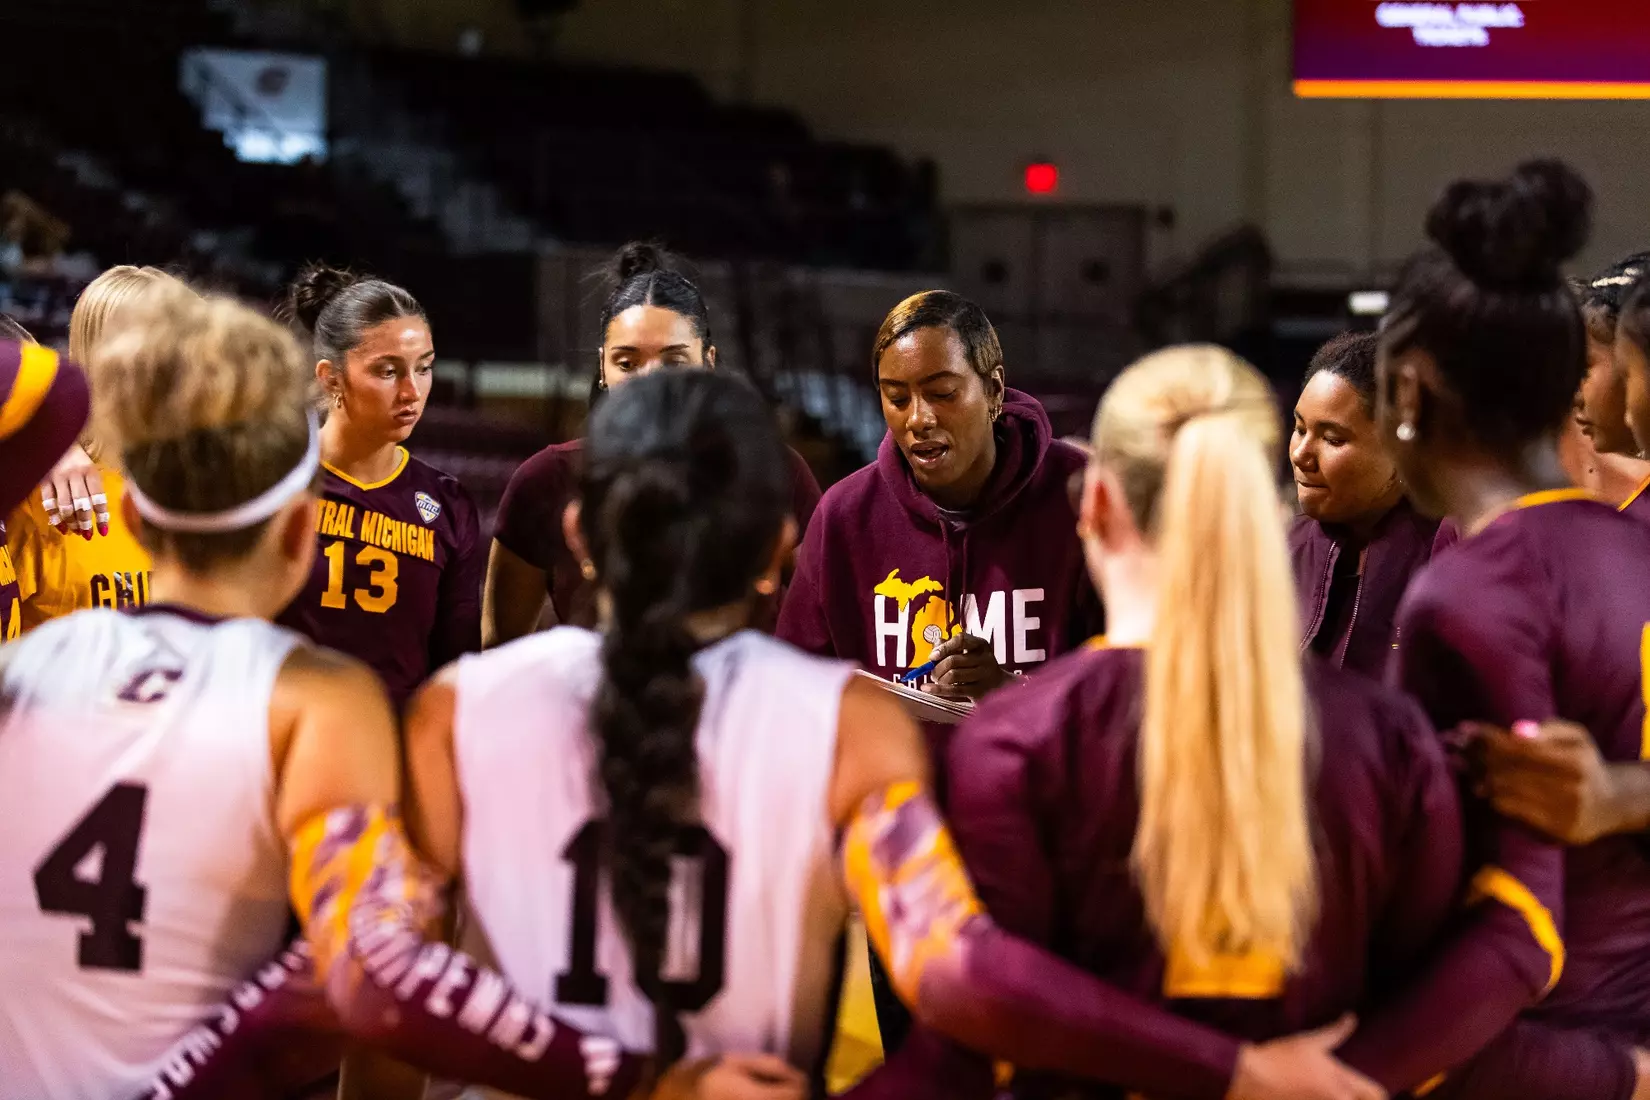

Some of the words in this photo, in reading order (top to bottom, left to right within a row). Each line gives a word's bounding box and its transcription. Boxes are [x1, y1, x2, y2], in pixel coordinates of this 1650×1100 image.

[321, 541, 398, 613] 13
[360, 510, 434, 562] MICHIGAN
[33, 780, 149, 973] 4
[554, 819, 732, 1011] 10
